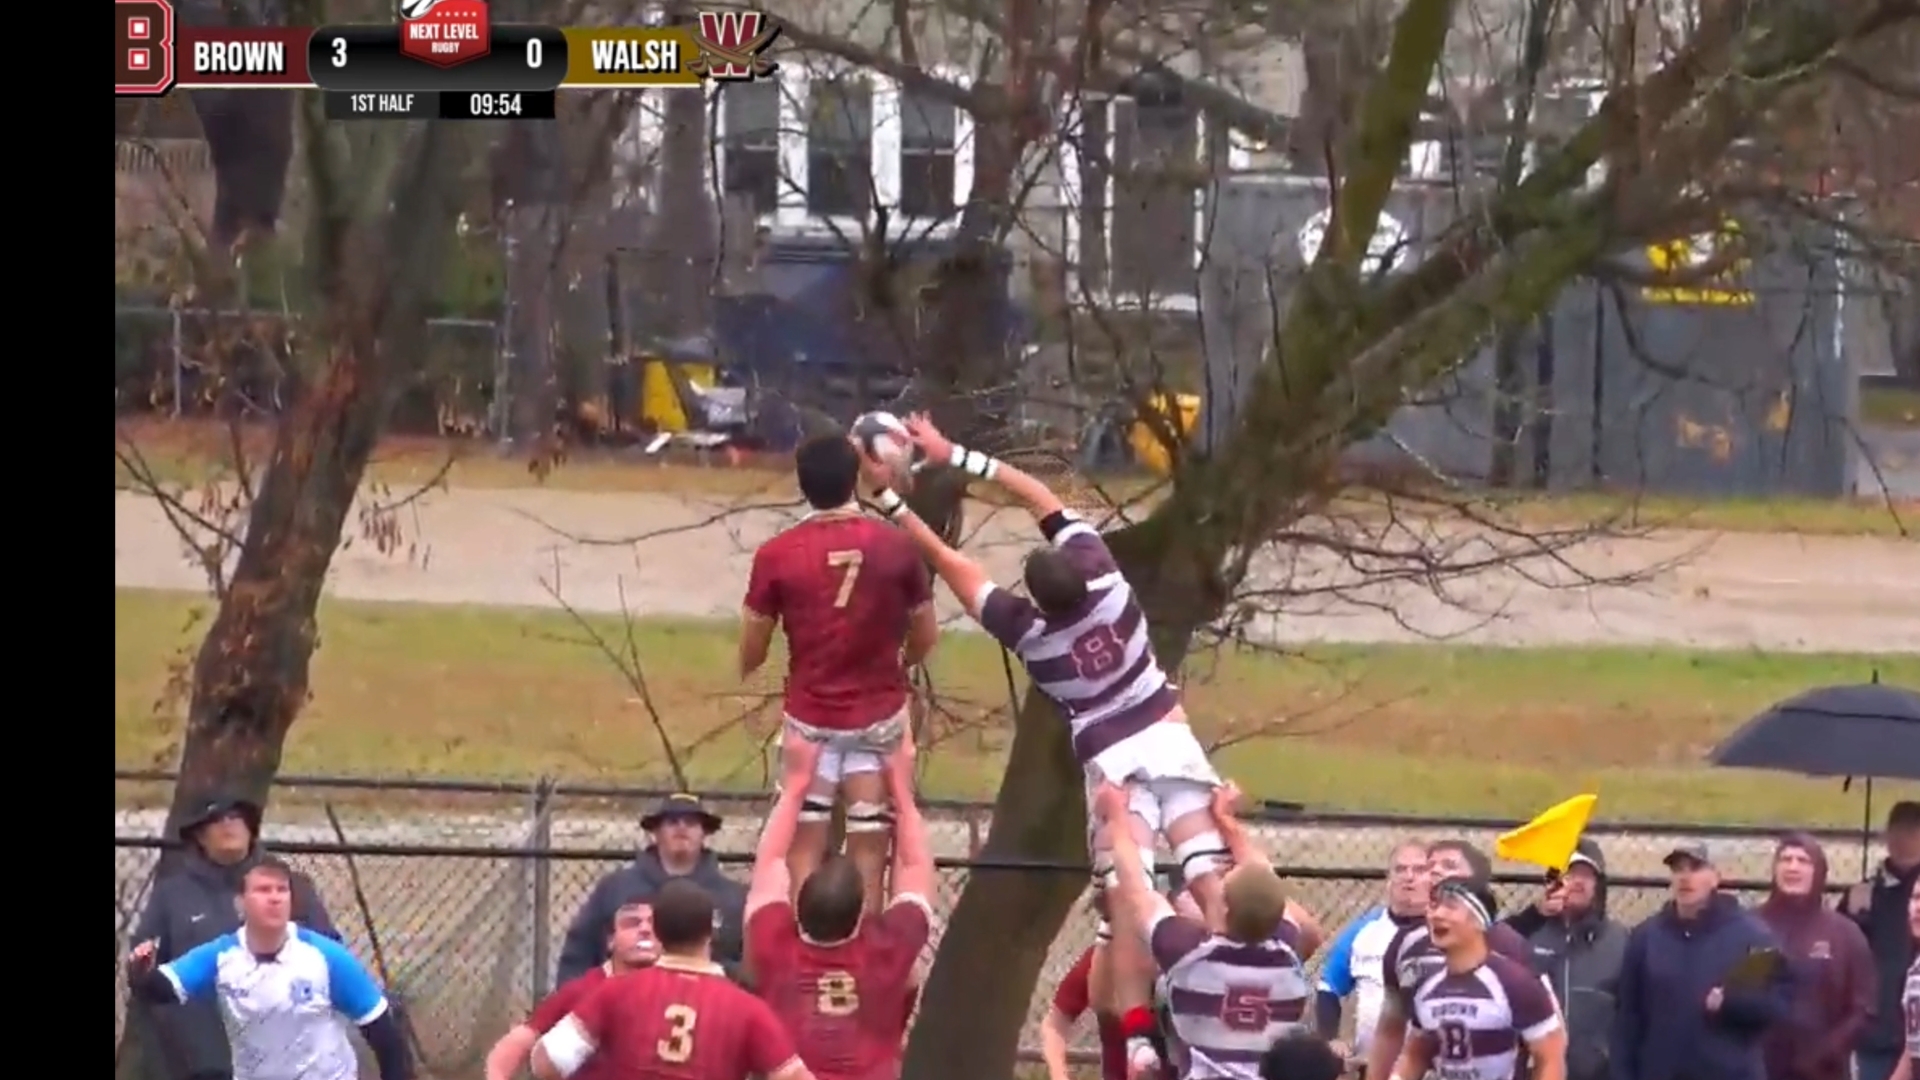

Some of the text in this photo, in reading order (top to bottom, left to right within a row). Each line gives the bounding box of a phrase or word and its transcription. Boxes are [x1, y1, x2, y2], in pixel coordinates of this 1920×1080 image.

[828, 550, 863, 607] 7
[1070, 622, 1127, 683] 8
[816, 970, 860, 1016] 8
[656, 1003, 697, 1063] 3
